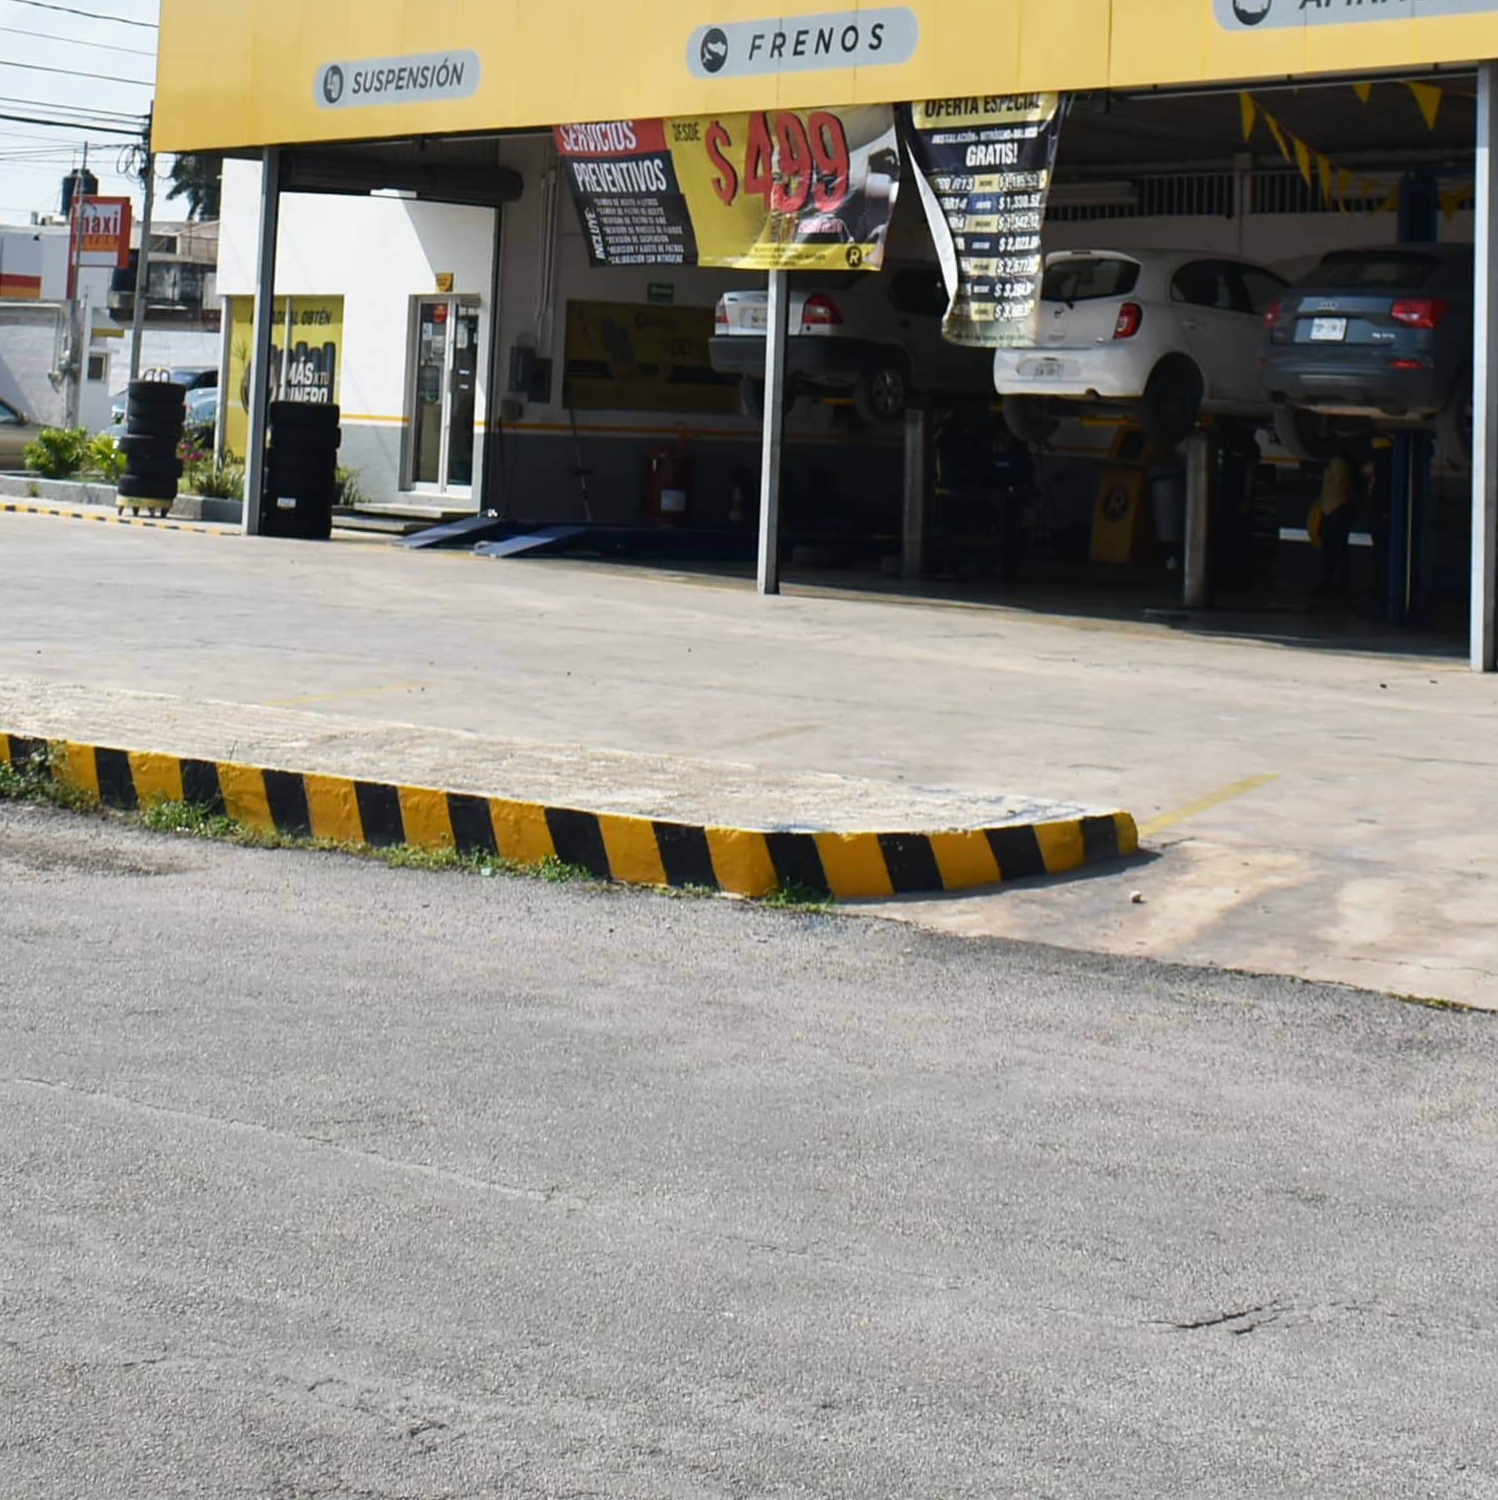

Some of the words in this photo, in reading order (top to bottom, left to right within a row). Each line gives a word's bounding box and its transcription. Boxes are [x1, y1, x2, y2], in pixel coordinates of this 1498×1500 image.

[748, 22, 885, 61] FRENOS
[351, 57, 465, 95] SUSPENSIÓN
[925, 99, 979, 118] OFERTA
[559, 119, 637, 152] SERVICIOS
[672, 122, 701, 143] DESDE
[965, 143, 1019, 167] GRATIS!
[572, 159, 667, 194] PREVENTIVOS
